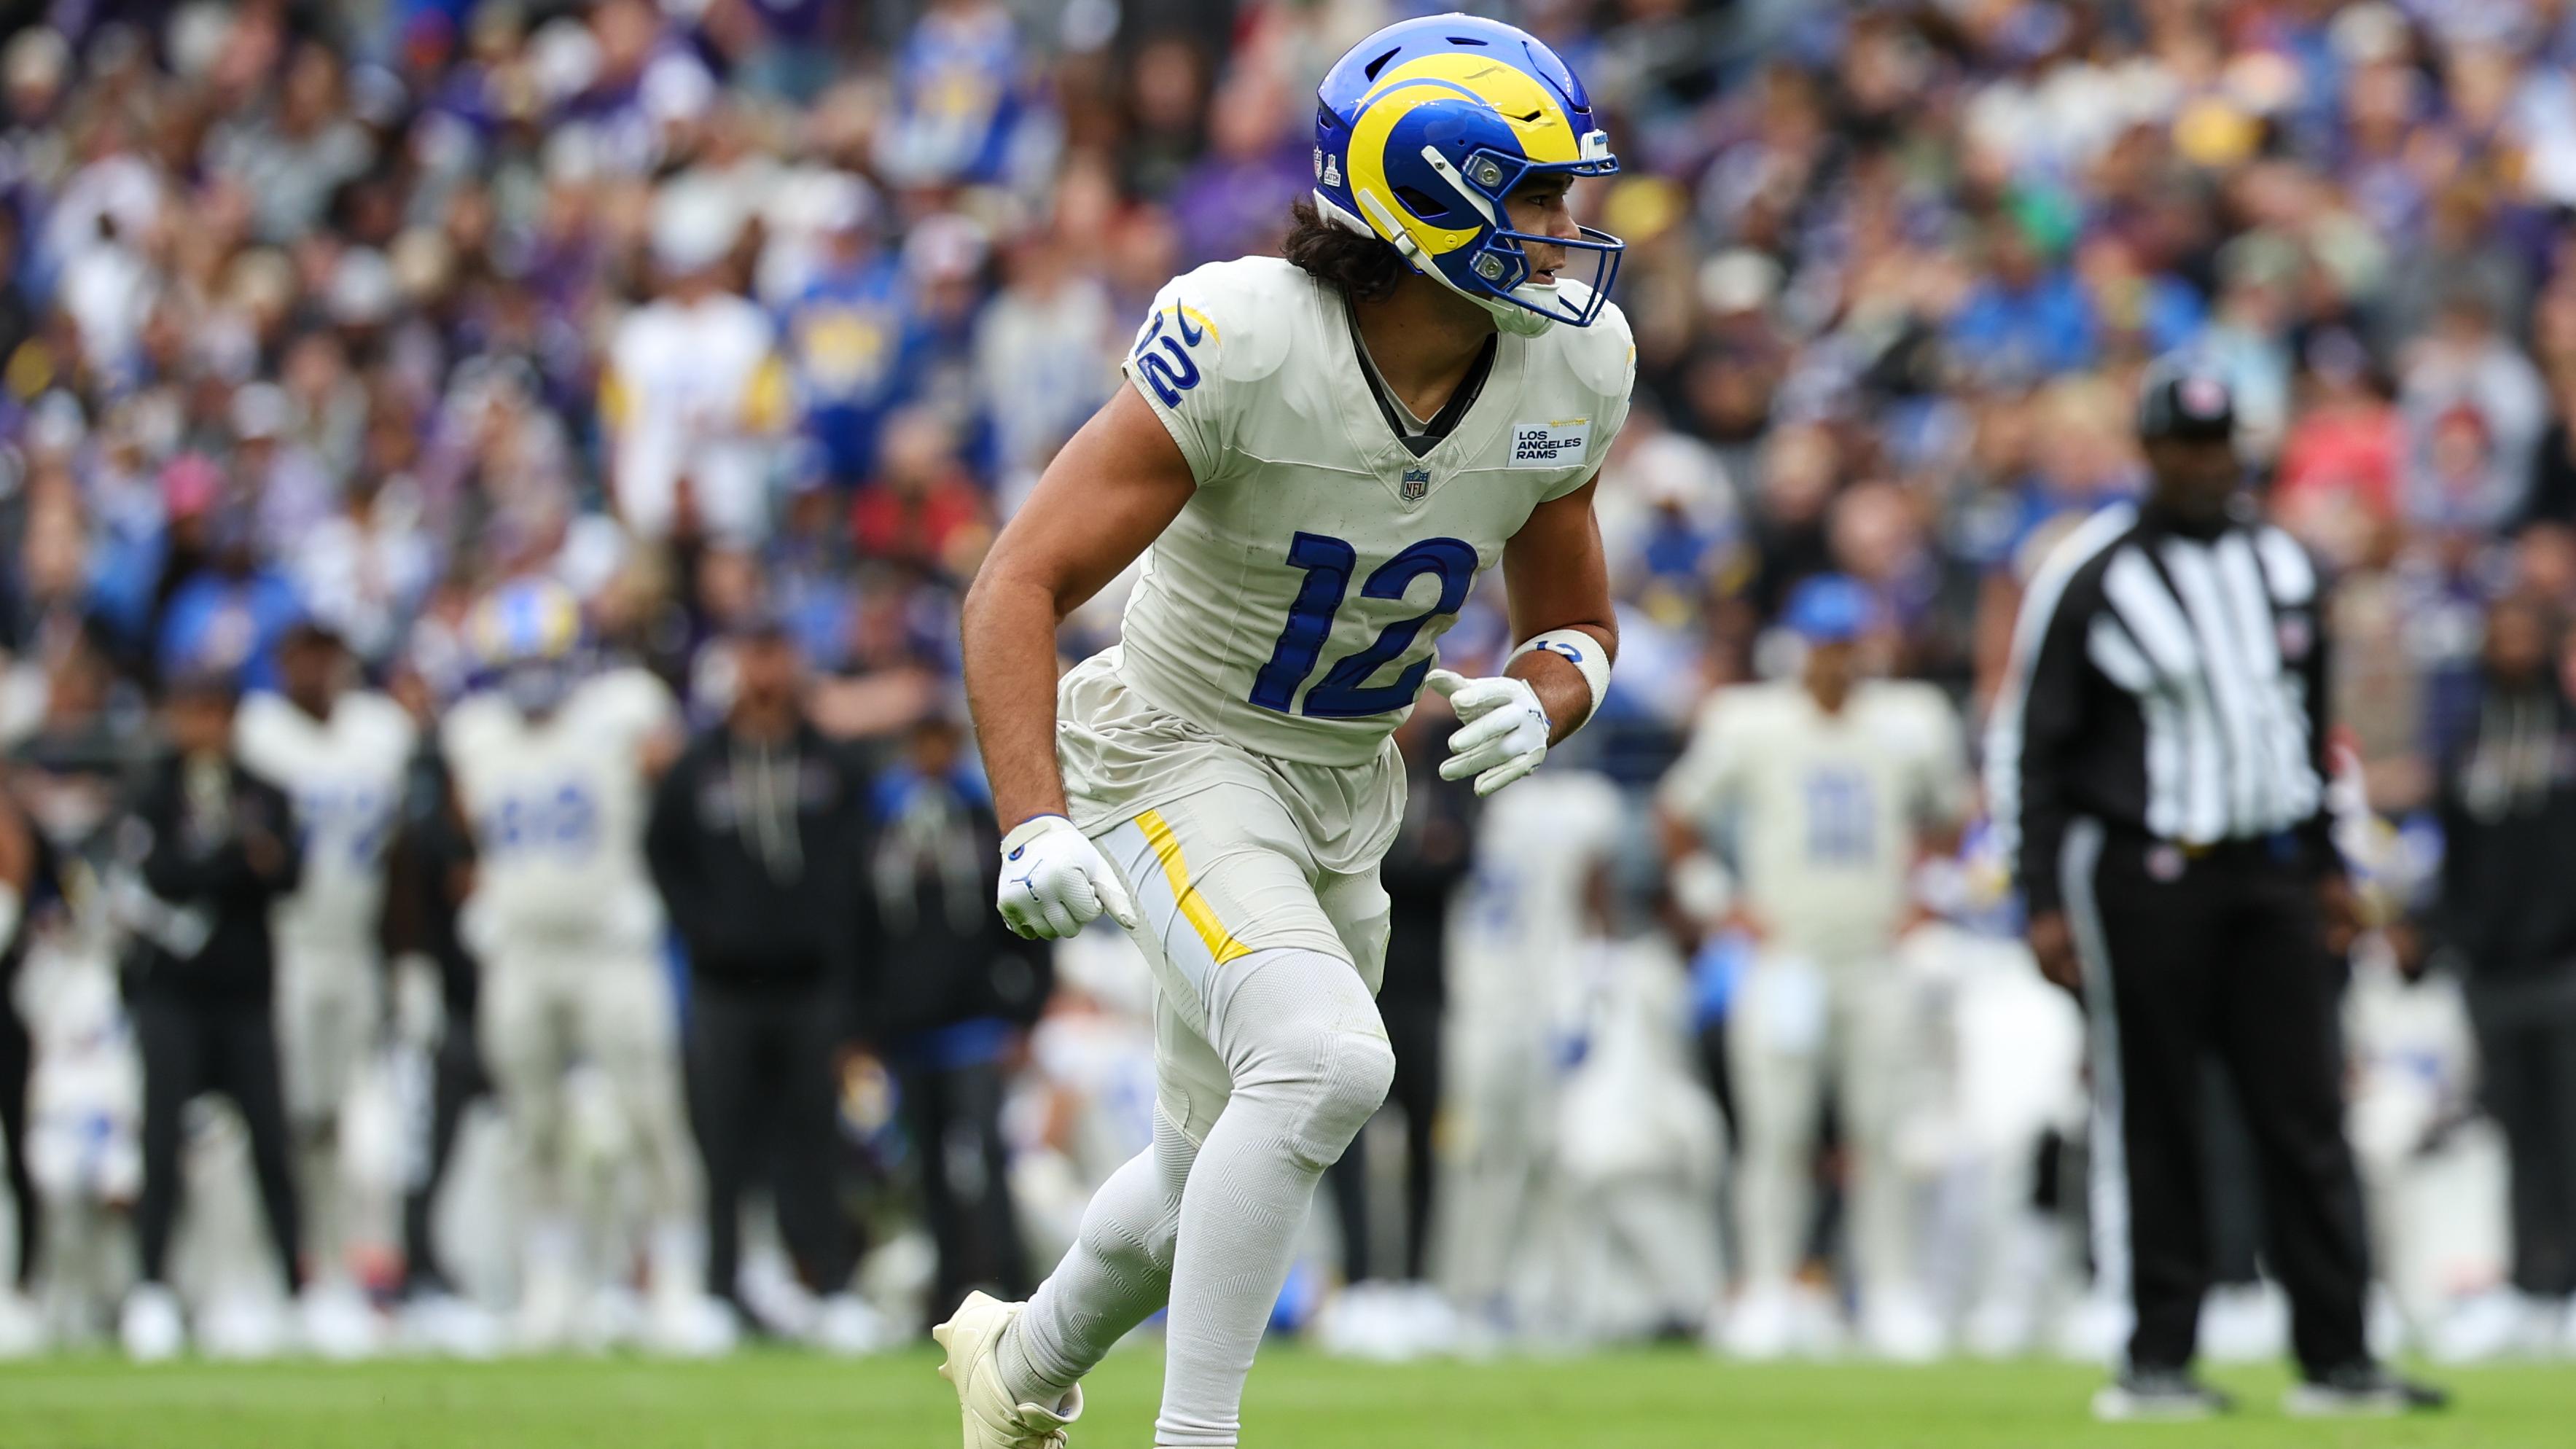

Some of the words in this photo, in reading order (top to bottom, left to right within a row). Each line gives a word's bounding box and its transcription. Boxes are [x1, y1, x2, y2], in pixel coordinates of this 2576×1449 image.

[1518, 431, 1547, 440] LOS
[1517, 437, 1582, 450] ANGELES
[1516, 450, 1558, 459] RAMS
[1405, 483, 1424, 496] NFL
[1249, 531, 1478, 717] 12
